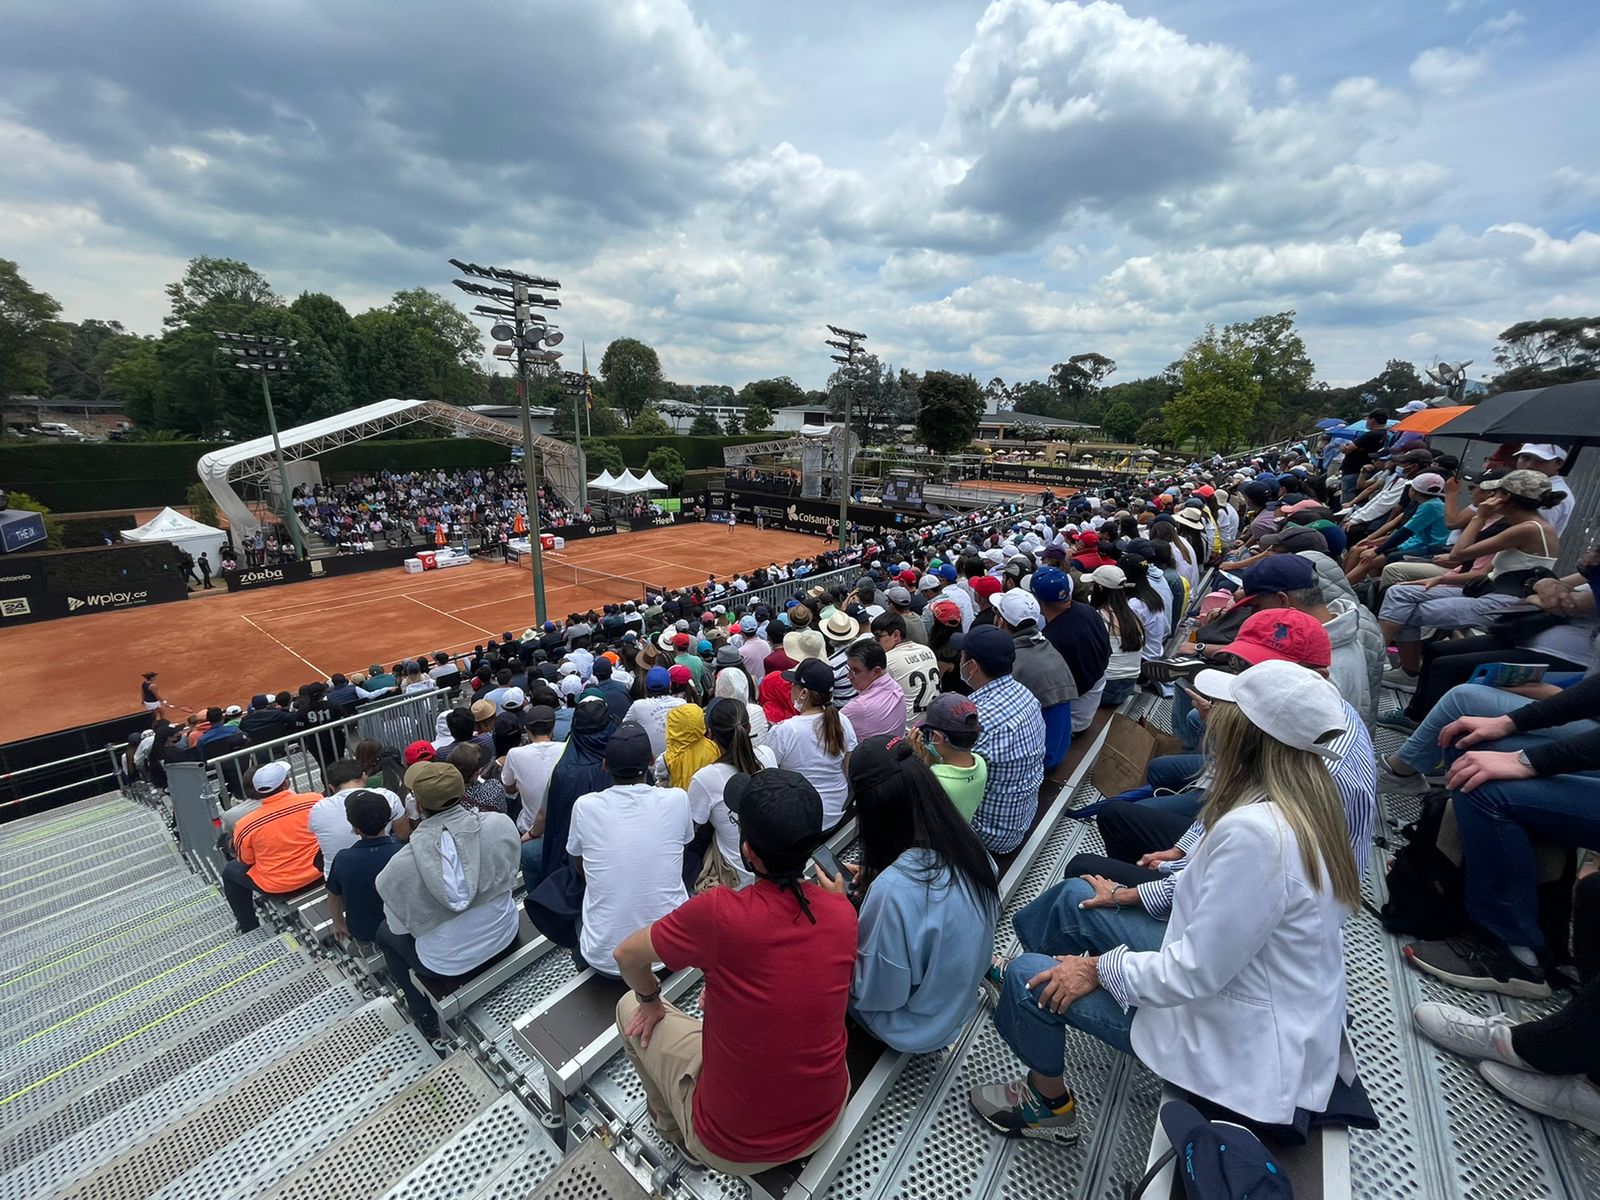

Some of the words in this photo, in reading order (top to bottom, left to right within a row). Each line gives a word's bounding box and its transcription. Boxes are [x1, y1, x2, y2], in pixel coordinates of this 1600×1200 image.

[799, 512, 840, 527] Colsanitas
[425, 556, 433, 564] G
[904, 655, 920, 665] LUIS
[307, 709, 331, 723] 911
